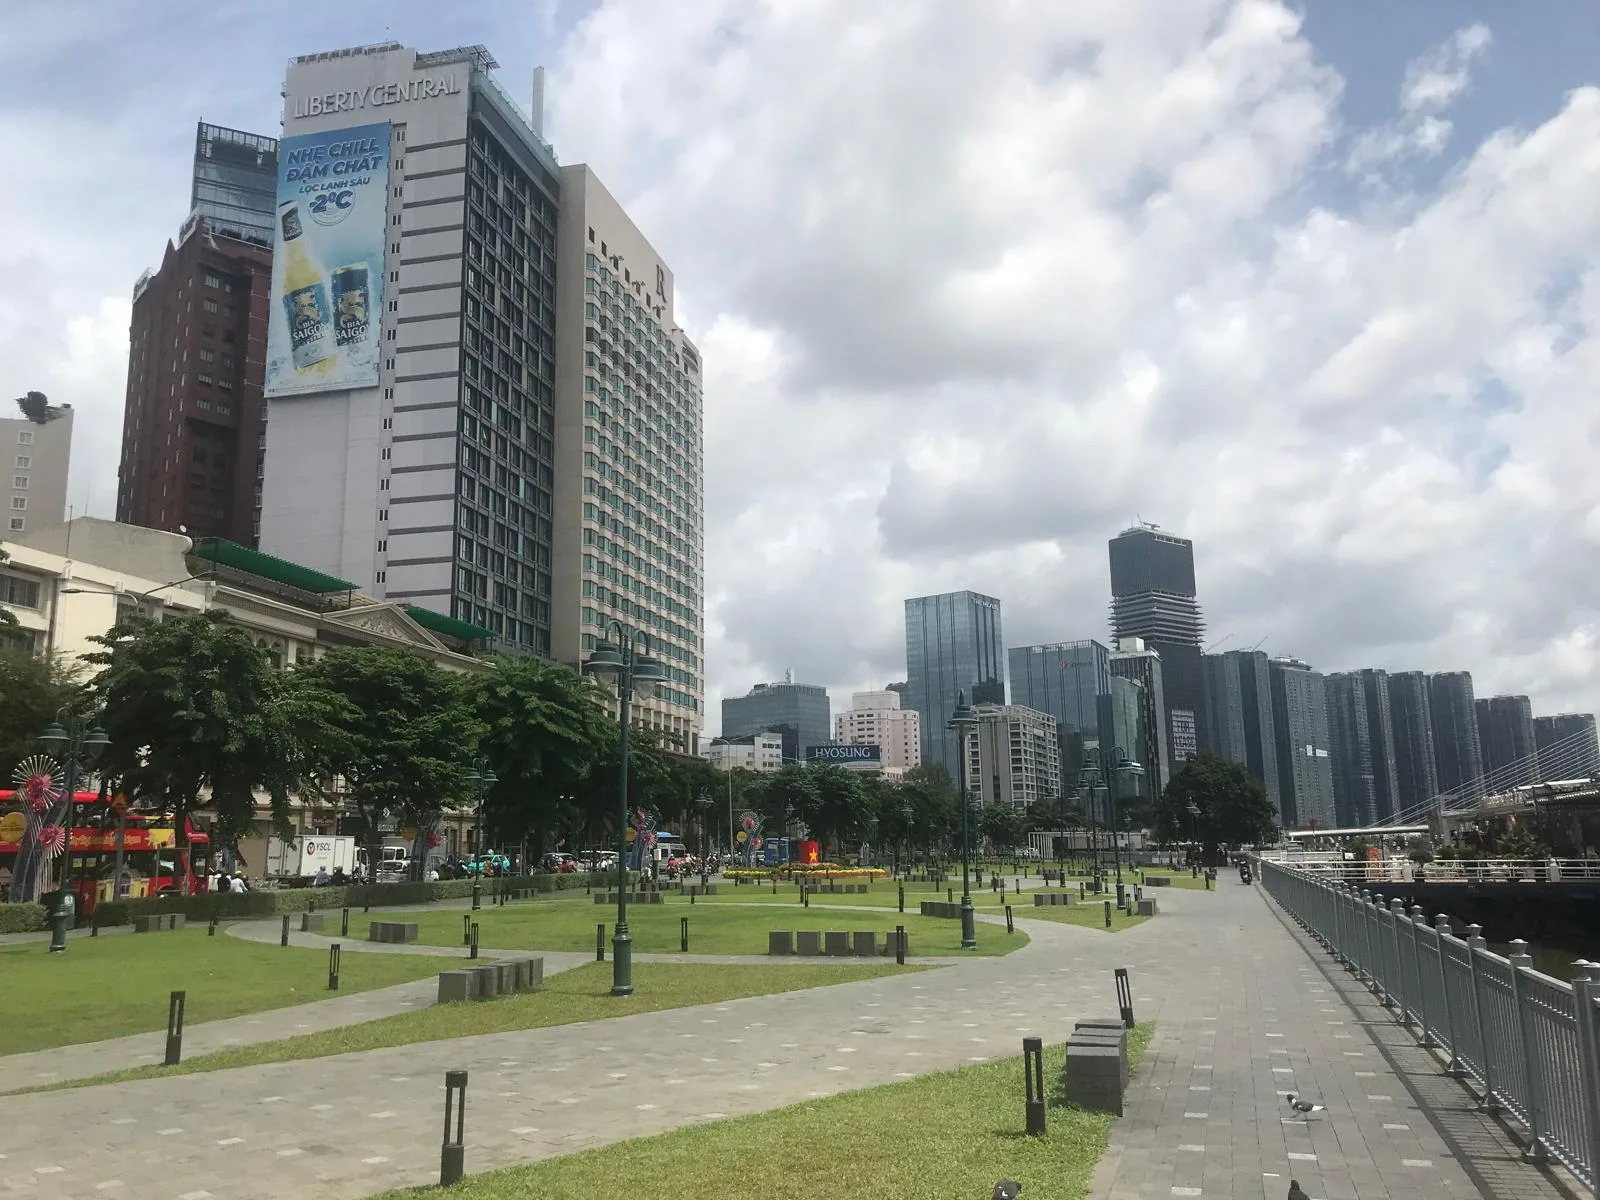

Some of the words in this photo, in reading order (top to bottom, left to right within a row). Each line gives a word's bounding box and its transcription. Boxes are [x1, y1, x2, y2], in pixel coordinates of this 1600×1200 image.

[294, 86, 370, 118] LIBERTY
[372, 74, 460, 106] CENTRAL
[287, 145, 326, 165] NHẸ
[328, 138, 379, 158] CHILL
[287, 163, 328, 183] ĐẬM
[333, 153, 383, 175] CHẤT
[347, 320, 361, 329] BIA
[815, 747, 871, 758] HYOSUNG
[316, 843, 331, 851] YSCL
